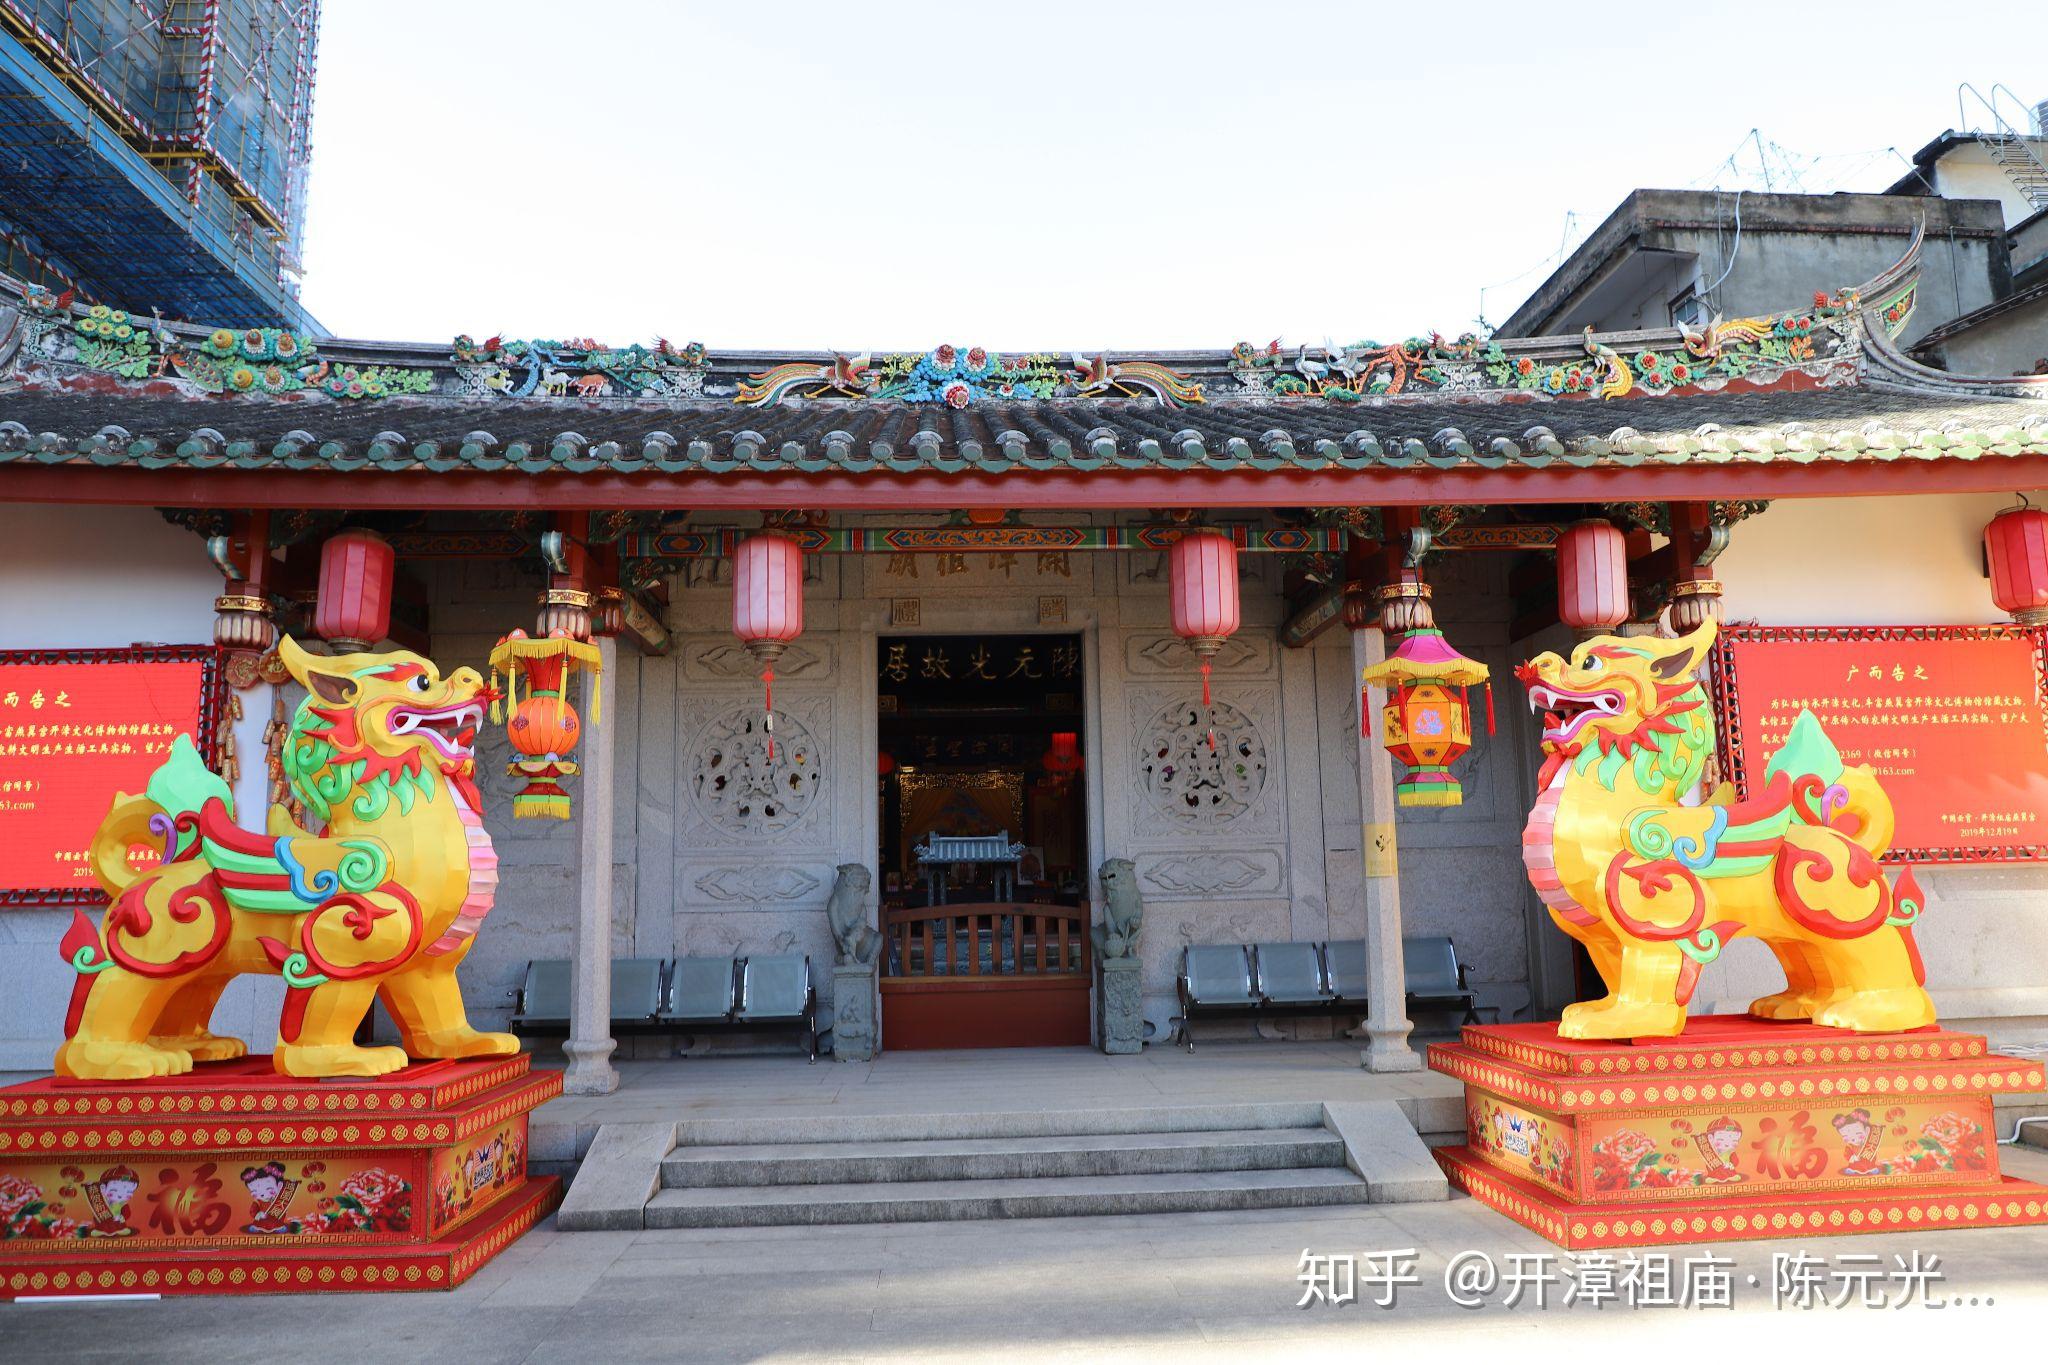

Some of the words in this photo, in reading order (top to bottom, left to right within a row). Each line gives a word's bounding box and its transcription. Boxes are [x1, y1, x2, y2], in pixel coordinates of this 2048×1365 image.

[1846, 663, 1929, 682] 广而告之
[1751, 1110, 1829, 1180] 福
[146, 1162, 232, 1236] 福
